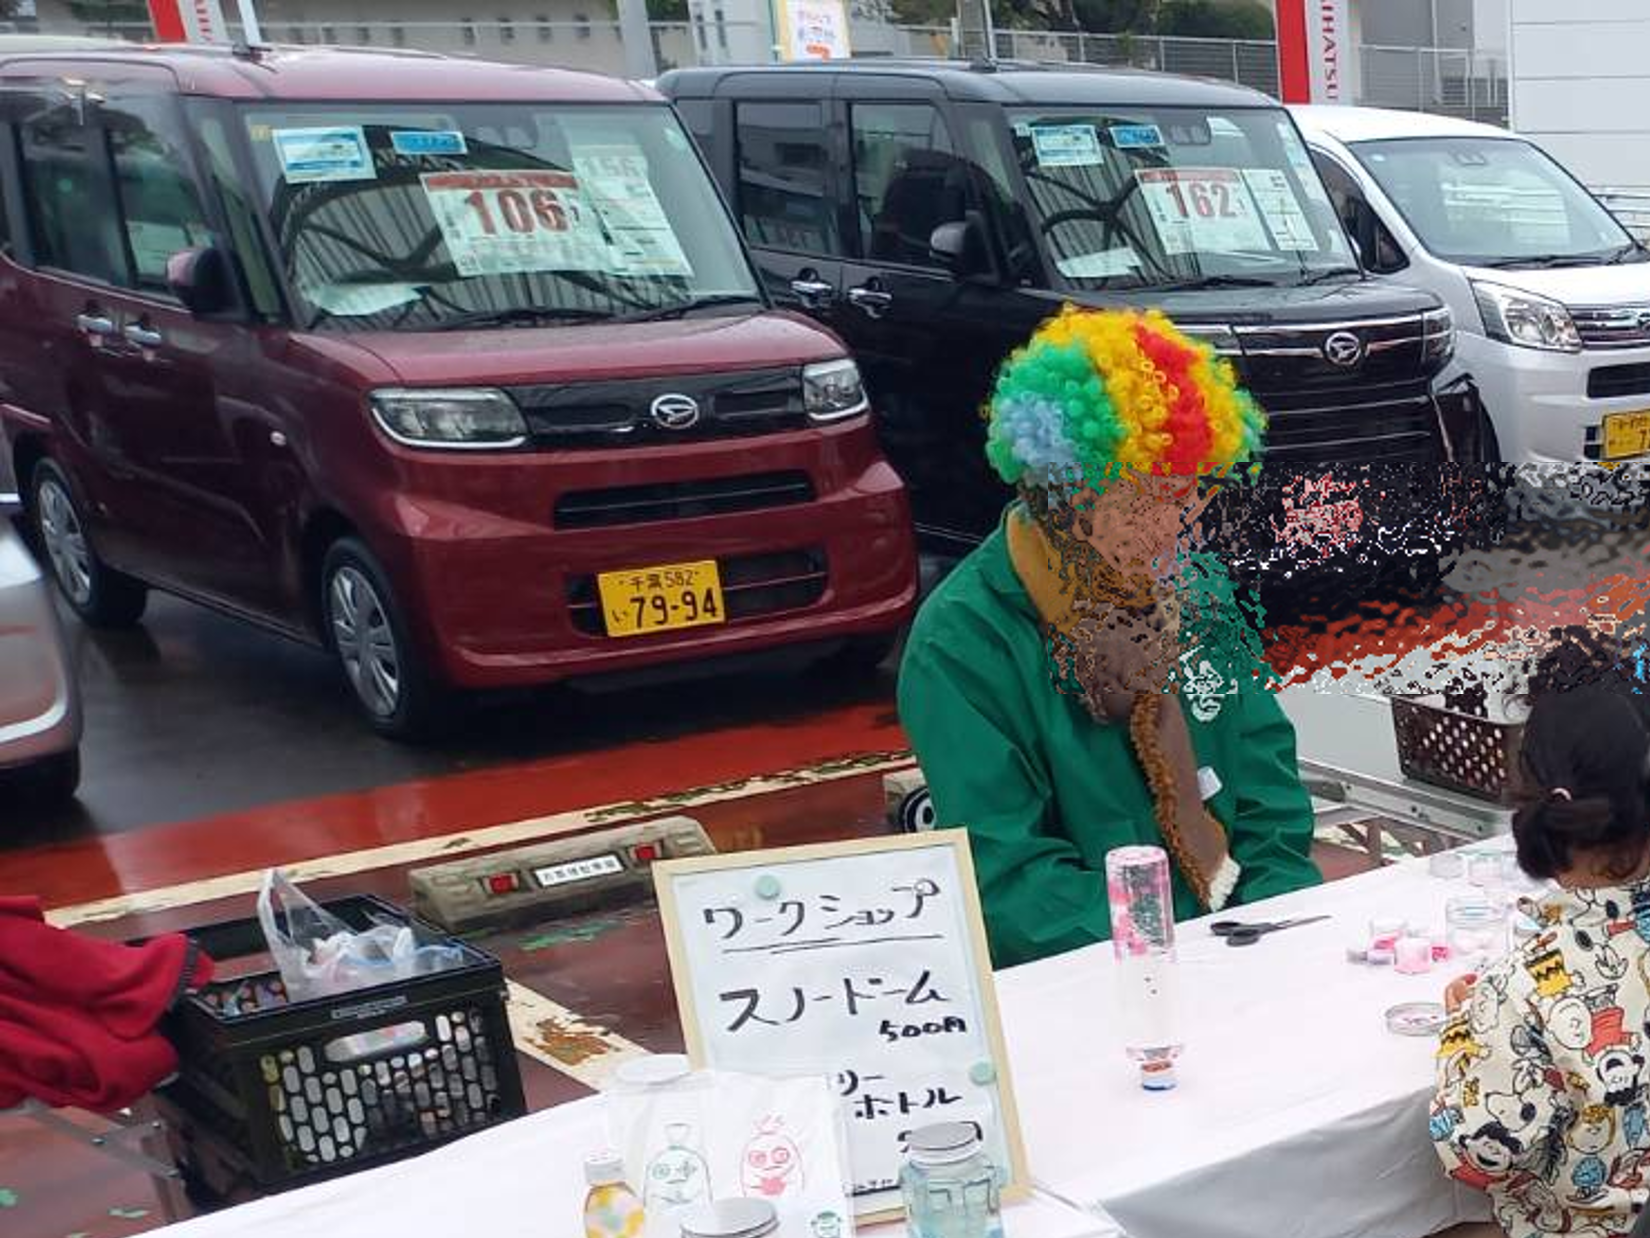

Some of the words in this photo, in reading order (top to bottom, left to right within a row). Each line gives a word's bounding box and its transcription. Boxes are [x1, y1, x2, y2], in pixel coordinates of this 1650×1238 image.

[464, 188, 569, 235] 106
[1166, 182, 1238, 219] 162
[629, 586, 718, 628] 79-94
[703, 878, 941, 940] ワークショップ
[718, 970, 951, 1032] スノードーム
[878, 1015, 967, 1042] 500円
[827, 1069, 887, 1097] リー
